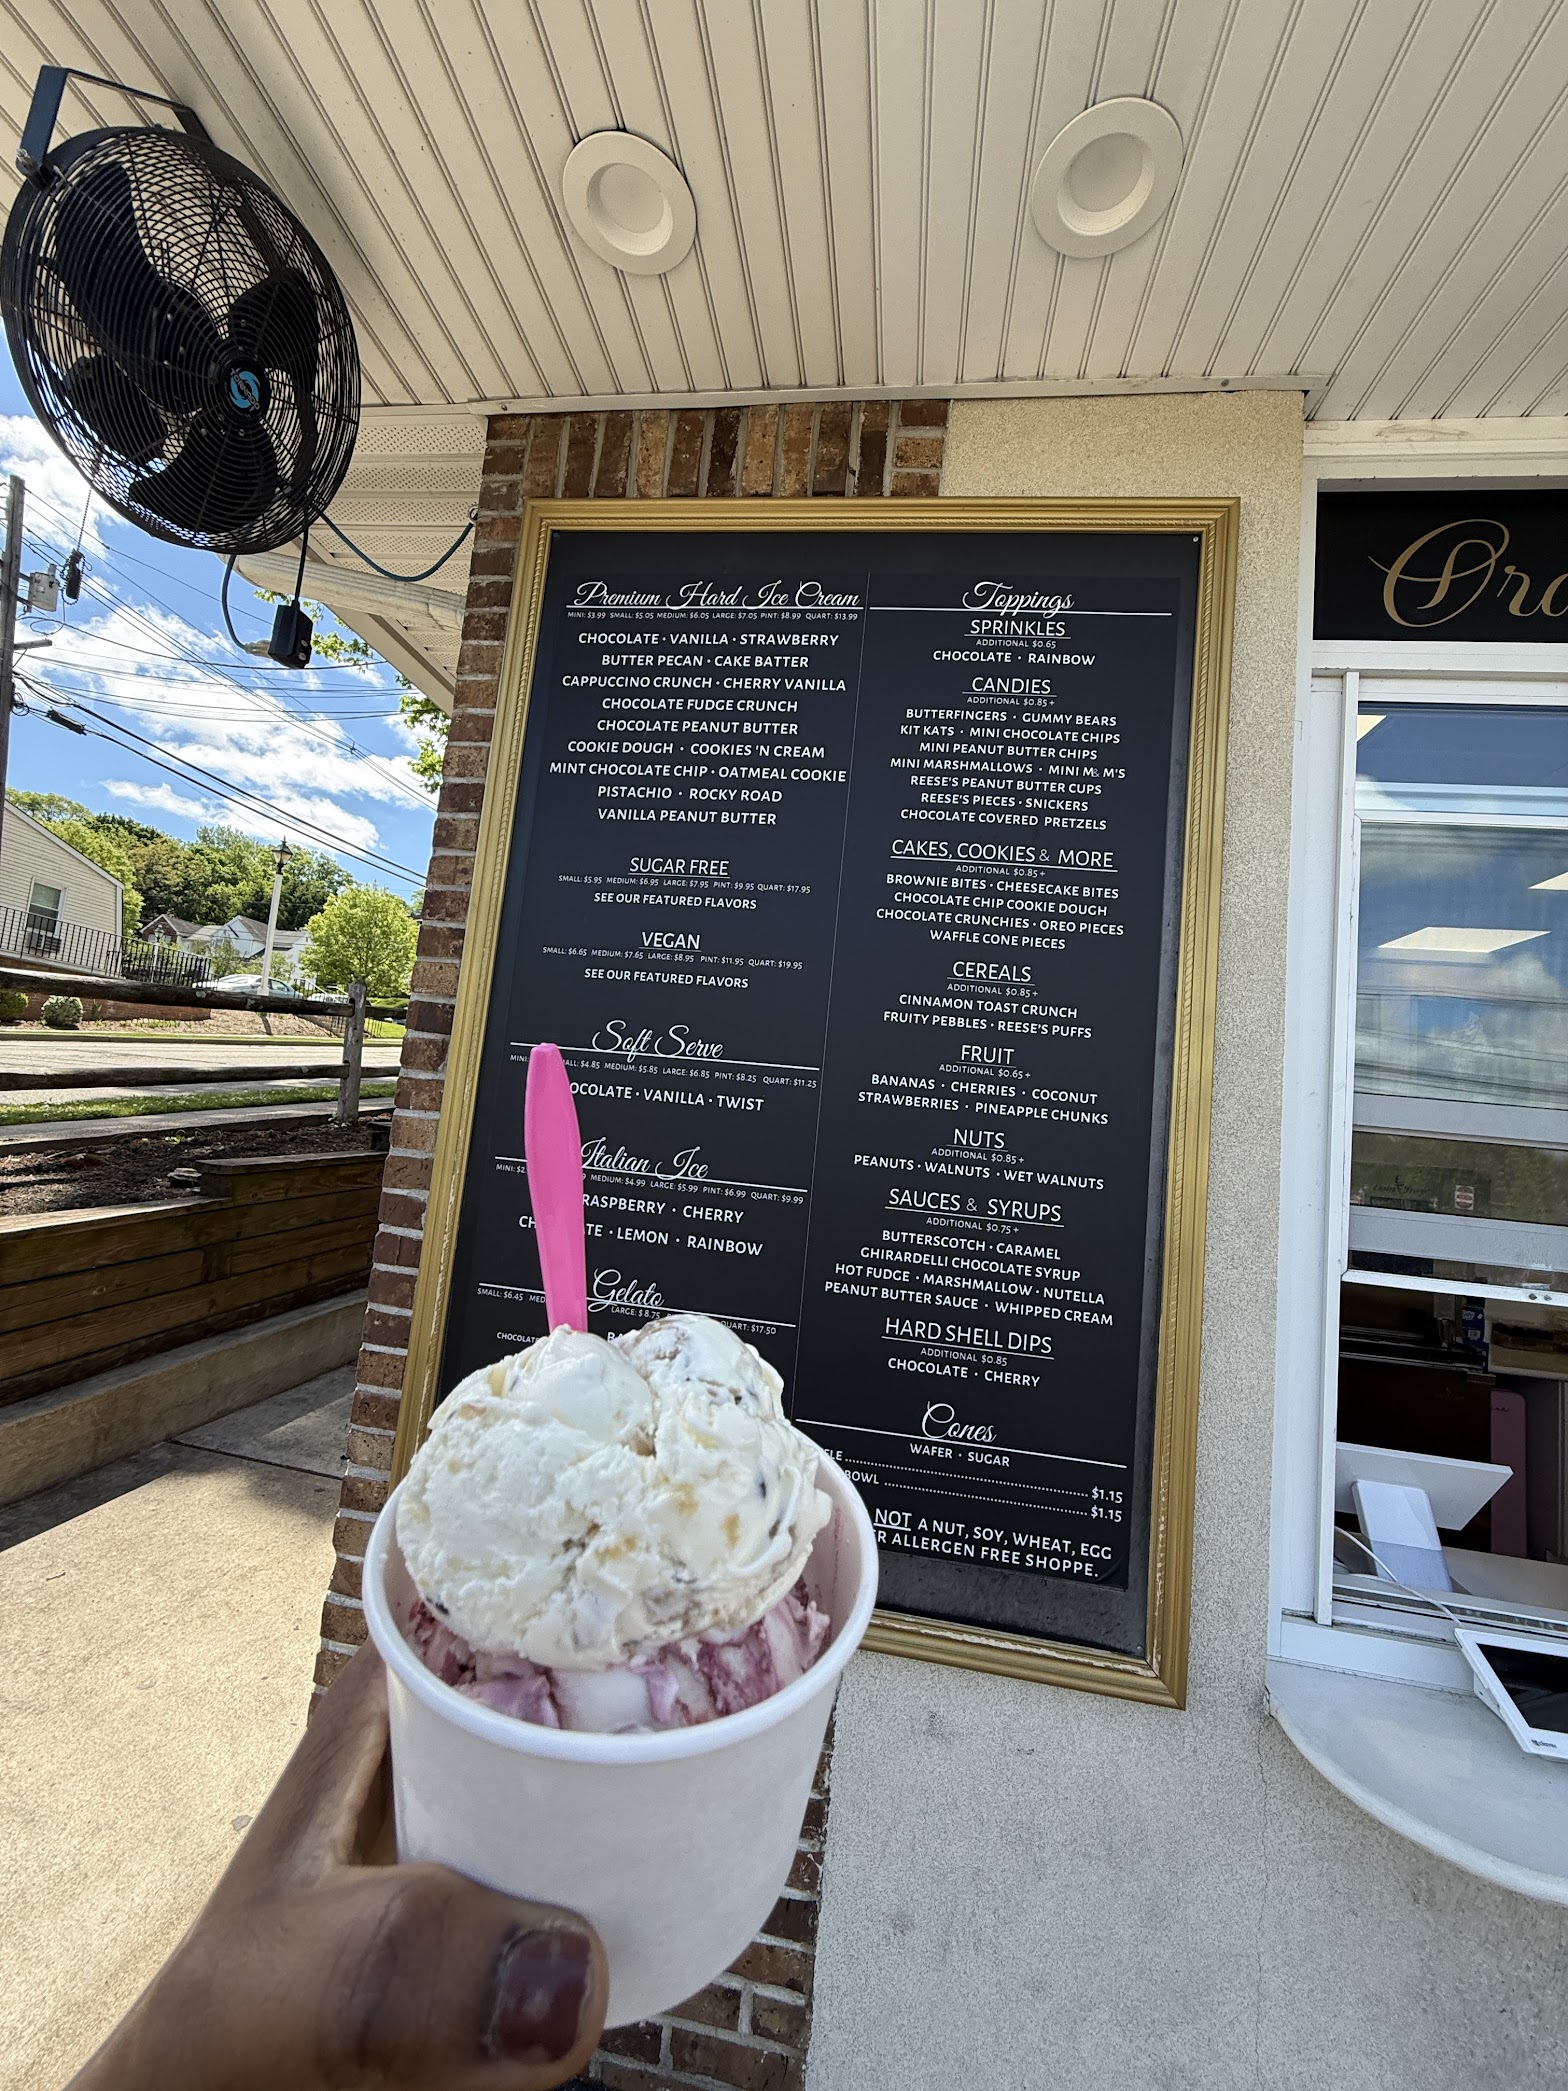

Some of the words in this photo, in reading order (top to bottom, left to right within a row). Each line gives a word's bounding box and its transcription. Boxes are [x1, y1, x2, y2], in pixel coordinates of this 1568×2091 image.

[573, 580, 661, 607] Premium
[665, 580, 743, 611] Hard
[741, 579, 789, 610] Ice
[794, 580, 861, 608] Cream
[961, 580, 1076, 619] Toppings
[578, 632, 660, 645] CHOCOLATE
[669, 633, 729, 645] VANILLA
[739, 633, 839, 646] STRAWBERRY
[969, 618, 1066, 637] SPRINKLES
[975, 638, 1029, 648] ADDITIONAL
[1031, 638, 1057, 649] $0.65
[601, 654, 654, 666] BUTTER
[656, 654, 704, 667] PECAN
[713, 655, 752, 667] CAKE
[753, 655, 809, 668] BATTER
[932, 649, 1012, 663] CHOCOLATE
[1027, 652, 1096, 666] RAINBOW
[561, 674, 651, 688] CAPPUCCINO
[652, 676, 713, 689] CRUNCH
[722, 676, 782, 690] CHERRY
[784, 677, 846, 691] VANILLA
[971, 676, 1051, 695] CANDIES
[905, 707, 1007, 722] BUTTERFINGERS
[1021, 712, 1073, 725] GUMMY
[1075, 714, 1117, 727] BEARS
[899, 724, 921, 735] KIT
[922, 725, 955, 737] KATS
[968, 726, 1000, 738] MINI
[1002, 728, 1079, 742] CHOCOLATE
[1080, 731, 1121, 744] CHIPS
[567, 740, 620, 753] COOKIE
[621, 741, 674, 754] DOUGH
[689, 742, 752, 756] COOKIES
[773, 744, 825, 759] CREAM
[549, 761, 587, 775] MINT
[588, 762, 672, 777] CHOCOLATE
[672, 764, 708, 777] CHIP
[717, 765, 788, 780] OATMEAL
[790, 768, 847, 782] COOKIE
[597, 785, 673, 799] PISTACHIO
[688, 787, 738, 801] ROCKY
[740, 789, 783, 803] ROAD
[910, 774, 959, 787] REESE'S
[961, 777, 1014, 790] PEANUT
[1015, 779, 1066, 793] BUTTER
[1068, 782, 1102, 795] CUPS
[900, 808, 976, 823] CHOCOLATE
[977, 812, 1039, 826] COVERED
[1043, 815, 1107, 830] PRETZELS
[891, 838, 953, 859] CAKES,
[956, 842, 1036, 863] COOKIES
[1038, 848, 1050, 862] &
[1057, 848, 1114, 868] MORE
[629, 856, 686, 874] SUGAR
[689, 858, 730, 876] FREE
[886, 873, 949, 888] BROWNIE
[950, 877, 987, 890] BITES
[995, 880, 1080, 897] CHEESECAKE
[1081, 886, 1119, 899] BITES
[593, 892, 615, 903] SEE
[615, 892, 641, 904] OUR
[642, 893, 703, 907] FEATURED
[704, 896, 757, 910] FLAVORS
[875, 907, 953, 923] CHOCOLATE
[953, 912, 1030, 929] CRUNCHIES
[1039, 919, 1077, 933] OREO
[1078, 922, 1124, 936] PIECES
[641, 931, 701, 950] VEGAN
[952, 960, 1031, 983] CEREALS
[898, 993, 974, 1010] CINNAMON
[976, 999, 1019, 1014] TOAST
[1020, 1003, 1078, 1019] CRUNCH
[883, 1010, 930, 1025] FRUITY
[931, 1014, 988, 1030] PEBBLES
[997, 1019, 1049, 1035] REESE'S
[1051, 1024, 1092, 1039] PUFFS
[591, 1019, 650, 1063] Soft
[653, 1023, 724, 1059] Serve
[960, 1044, 1015, 1065] FRUIT
[643, 1087, 705, 1106] VANILLA
[716, 1094, 765, 1111] TWIST
[871, 1073, 936, 1090] BANANAS
[950, 1080, 1016, 1098] CHERRIES
[1031, 1088, 1098, 1105] COCONUT
[857, 1090, 959, 1111] STRAWBERRIES
[974, 1101, 1049, 1120] PINEAPPLE
[1050, 1108, 1109, 1125] CHUNKS
[953, 1127, 1005, 1149] NUTS
[580, 1136, 651, 1173] Italian
[654, 1145, 709, 1180] Ice
[853, 1153, 914, 1171] PEANUTS
[924, 1160, 990, 1179] WALNUTS
[1003, 1168, 1034, 1183] WET
[1036, 1172, 1104, 1190] WALNUTS
[582, 1193, 666, 1215] RASPBERRY
[682, 1204, 744, 1224] CHERRY
[888, 1187, 961, 1212] SAUCES
[965, 1197, 978, 1212] &
[986, 1198, 1062, 1222] SYRUPS
[616, 1226, 669, 1245] LEMON
[686, 1234, 764, 1256] RAINBOW
[881, 1229, 986, 1252] BUTTERSCOTCH
[995, 1242, 1061, 1261] CARAMEL
[859, 1246, 949, 1267] GHIRARDELLI
[951, 1256, 1033, 1277] CHOCOLATE
[1034, 1266, 1081, 1282] SYRUP
[588, 1267, 665, 1313] Gelato
[834, 1262, 864, 1277] HOT
[865, 1266, 910, 1282] FUDGE
[922, 1272, 1033, 1296] MARSHMALLOW
[1042, 1286, 1105, 1305] NUTELLA
[824, 1280, 879, 1298] PEANUT
[880, 1287, 932, 1305] BUTTER
[934, 1293, 979, 1310] SAUCE
[994, 1300, 1062, 1320] WHIPPED
[1063, 1309, 1113, 1326] CREAM
[885, 1316, 942, 1340] HARD
[944, 1324, 1003, 1348] SHELL
[1007, 1331, 1052, 1354] DIPS
[919, 1346, 978, 1362] ADDITIONAL
[980, 1353, 1008, 1367] $0.85
[920, 1400, 998, 1444] Cones
[909, 1442, 953, 1459] WAFER
[967, 1450, 1010, 1467] SUGAR
[1091, 1485, 1123, 1504] $1.15
[1090, 1504, 1122, 1523] $1.15
[874, 1507, 912, 1528] NOT
[917, 1517, 928, 1532] A
[932, 1519, 969, 1540] NUT,
[972, 1525, 1008, 1546] SOY,
[1012, 1531, 1076, 1557] WHEAT,
[1080, 1542, 1112, 1560] EGG
[890, 1532, 975, 1558] ALLERGEN
[980, 1545, 1021, 1565] FREE
[1024, 1553, 1098, 1578] SHOPPE.
